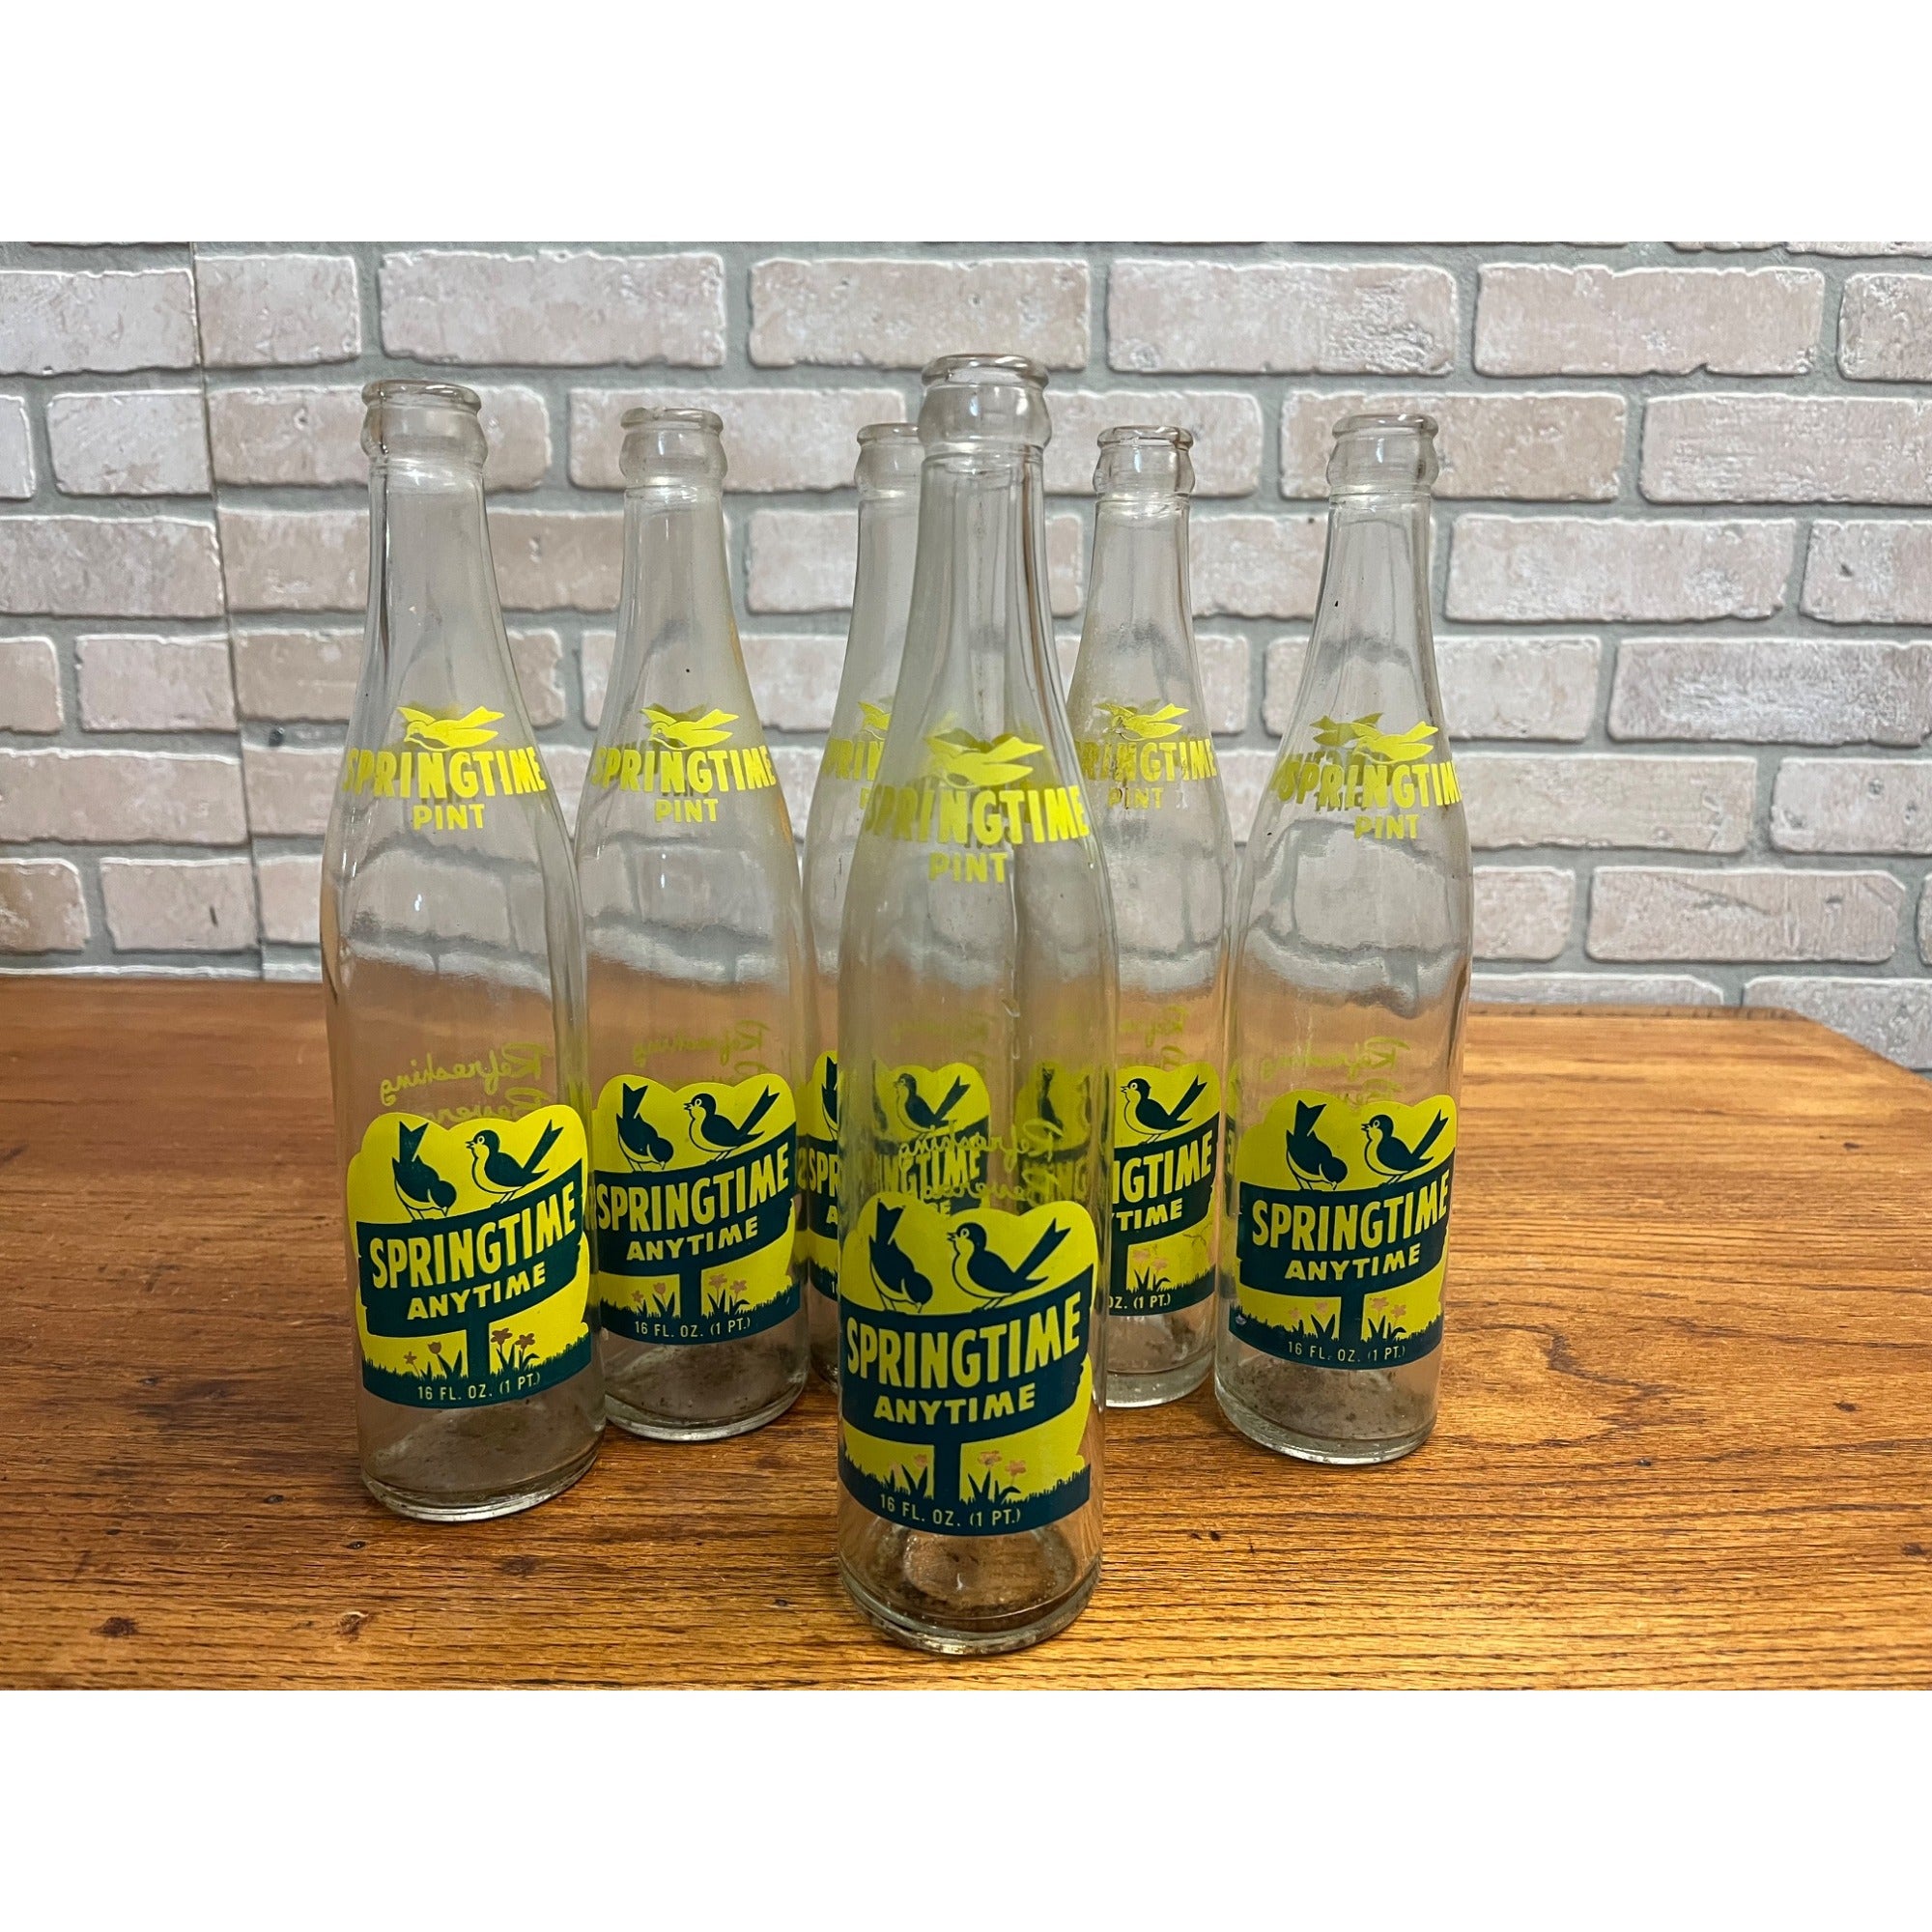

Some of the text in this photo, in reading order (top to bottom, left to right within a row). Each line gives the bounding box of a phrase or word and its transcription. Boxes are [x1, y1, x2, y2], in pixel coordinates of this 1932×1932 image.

[343, 747, 547, 799] SPRINGTIME
[592, 745, 777, 793] SPRINGTIME
[412, 804, 485, 831] PINT
[654, 798, 719, 823] PINT
[866, 784, 1089, 846] SPRINGTIME
[1108, 787, 1164, 810] PINT
[1354, 813, 1420, 839] PINT
[928, 851, 1008, 883] PINT
[597, 1142, 789, 1233] SPRINGTIME
[1252, 1168, 1450, 1253] SPRINGTIME
[370, 1180, 577, 1289] SPRINGTIME
[626, 1216, 758, 1262] ANYTIME
[1284, 1242, 1421, 1281] ANYTIME
[407, 1261, 546, 1321] ANYTIME
[1133, 1295, 1144, 1309] (1
[1150, 1293, 1171, 1308] PT.)
[635, 1317, 751, 1338] 16 FL. OZ. (1 PT.)
[846, 1291, 1081, 1389] SPRINGTIME
[1288, 1341, 1303, 1355] 16
[1309, 1345, 1331, 1360] FL.
[1338, 1349, 1361, 1363] OZ.
[1384, 1346, 1406, 1360] PT.)
[417, 1372, 541, 1401] 16 FL. OZ. (1 PT.)
[873, 1382, 1036, 1426] ANYTIME
[880, 1493, 1021, 1527] 16 FL. OZ. (1 PT.)
